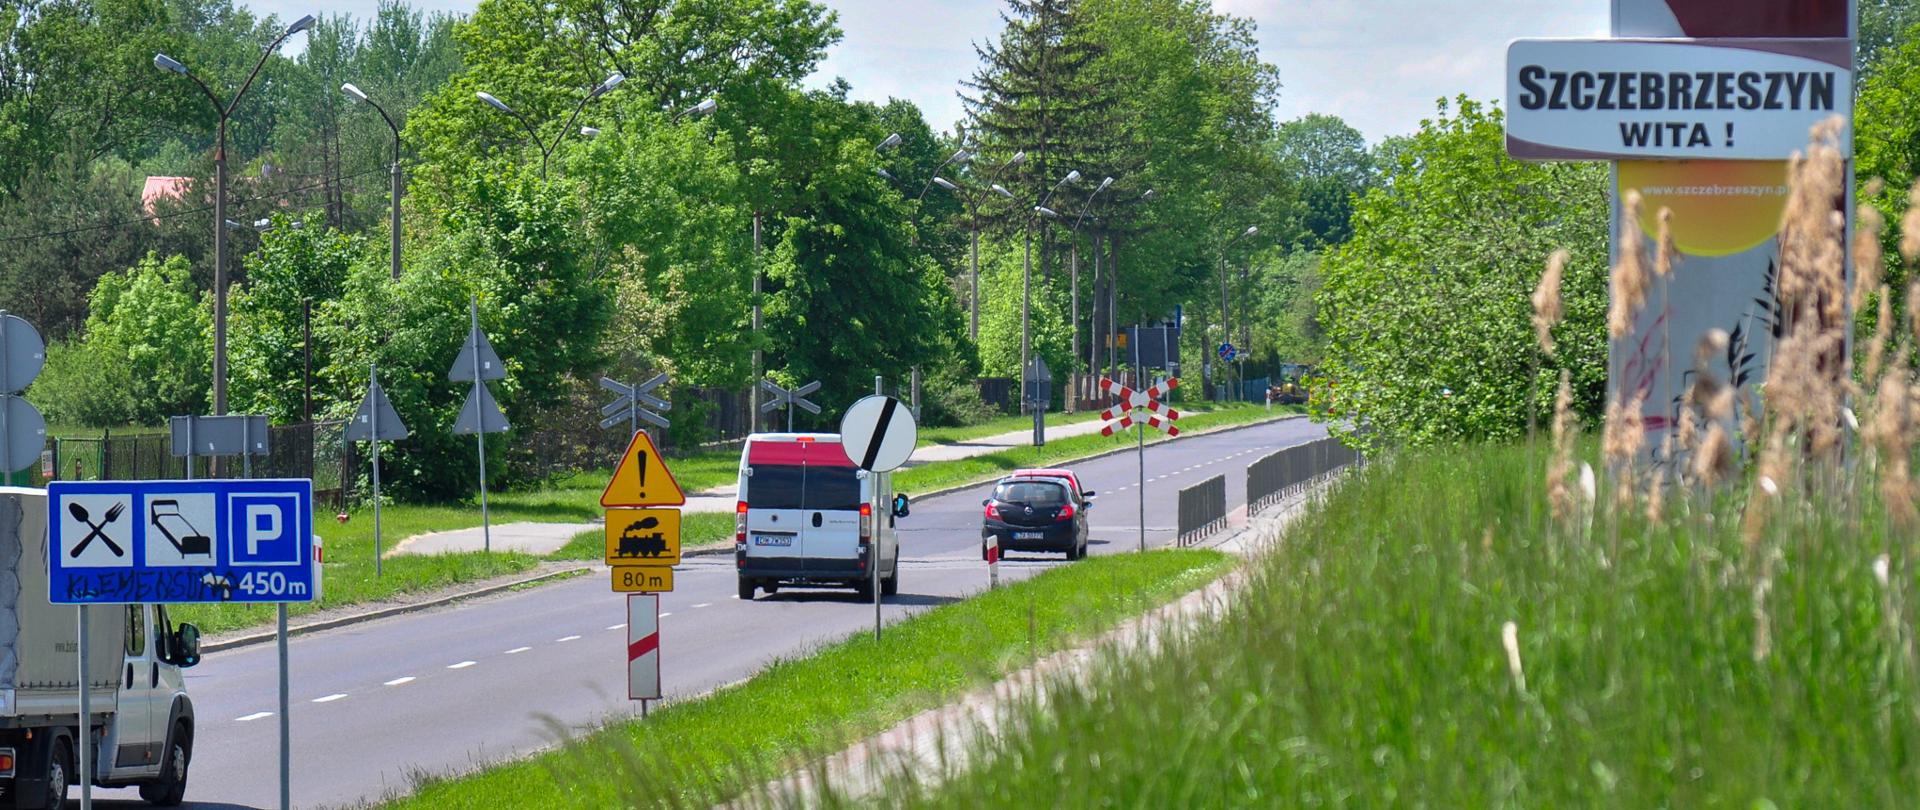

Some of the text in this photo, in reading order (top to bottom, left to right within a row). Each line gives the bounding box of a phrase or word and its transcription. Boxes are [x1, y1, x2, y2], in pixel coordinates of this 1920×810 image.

[1518, 64, 1835, 111] SZCZEBRZESZYN
[1619, 122, 1735, 148] WITA !
[1642, 183, 1790, 197] www.szczebrzeszyn.pl
[246, 504, 283, 555] P
[623, 571, 663, 587] 80 m
